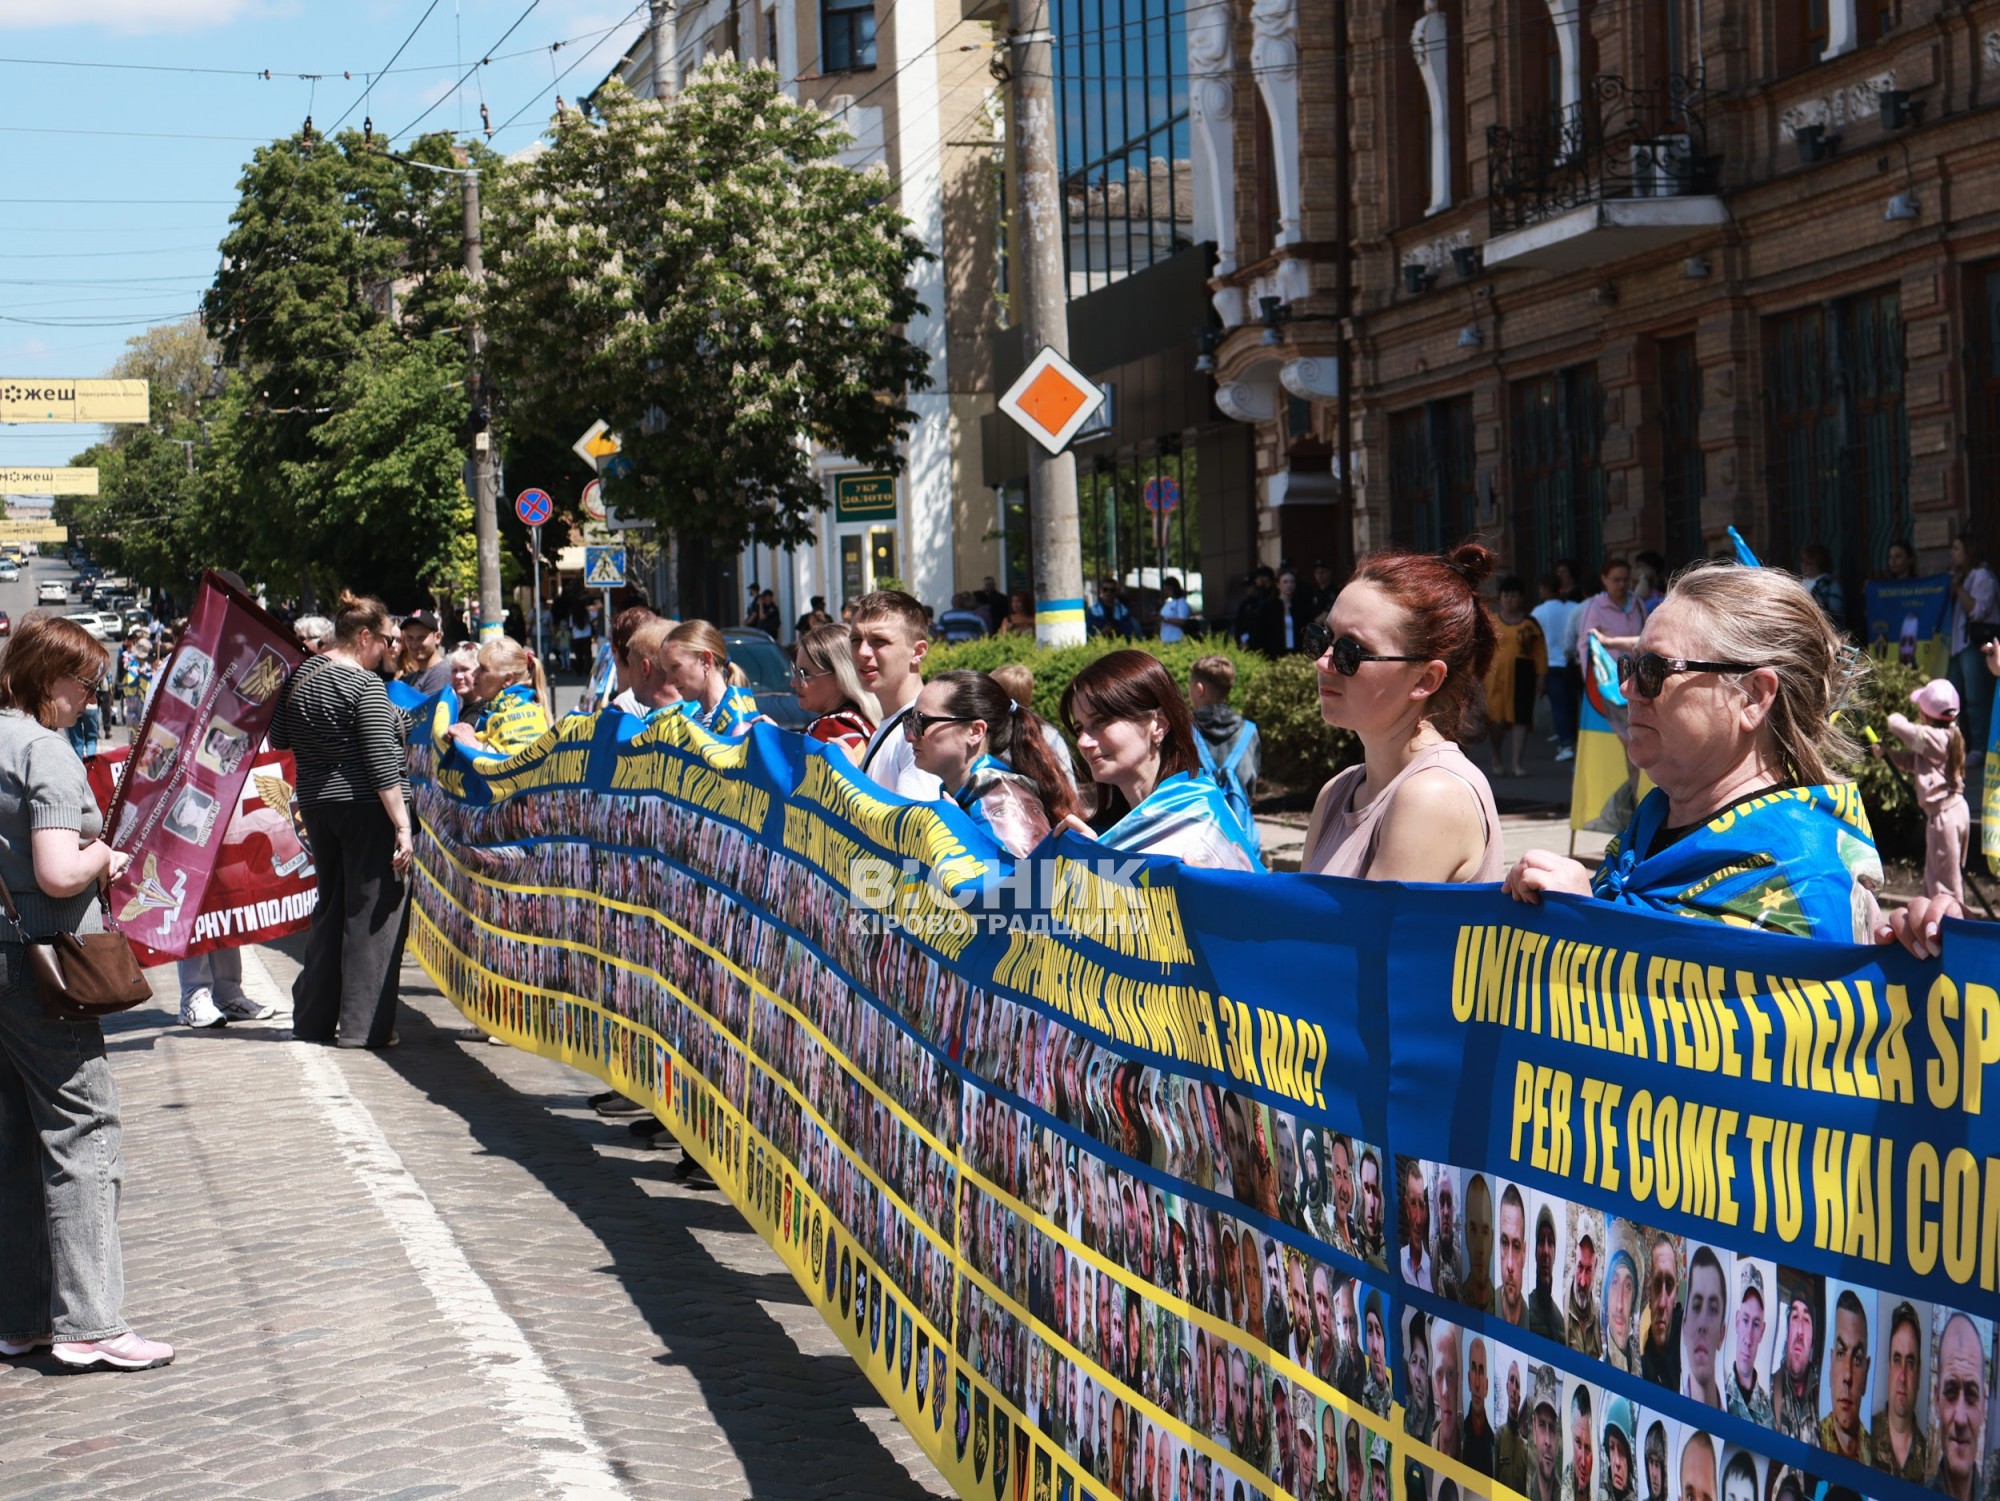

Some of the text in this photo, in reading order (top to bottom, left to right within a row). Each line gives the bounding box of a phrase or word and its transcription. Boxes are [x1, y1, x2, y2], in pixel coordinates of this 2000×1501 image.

[843, 493, 892, 504] ЗОЛОТО
[856, 484, 878, 492] УКР
[1687, 880, 1707, 899] EST
[1011, 930, 1072, 1015] БОРЕМОСЯ
[1068, 951, 1087, 1024] ЗА
[1136, 981, 1224, 1072] БОРОЛИСЯ
[1218, 995, 1262, 1087] ЗА
[1257, 1006, 1328, 1111] НАС!
[1451, 925, 1549, 1035] UNITI
[1549, 940, 1648, 1059] NELLA
[1646, 953, 1744, 1078] FEDE
[1736, 970, 1774, 1075] E
[1773, 975, 1915, 1106] NELLA
[1510, 1060, 1574, 1178] PER
[1579, 1076, 1621, 1193] TE
[1626, 1088, 1743, 1242] COME
[1745, 1113, 1804, 1244] TU
[1813, 1126, 1894, 1266] HAI
